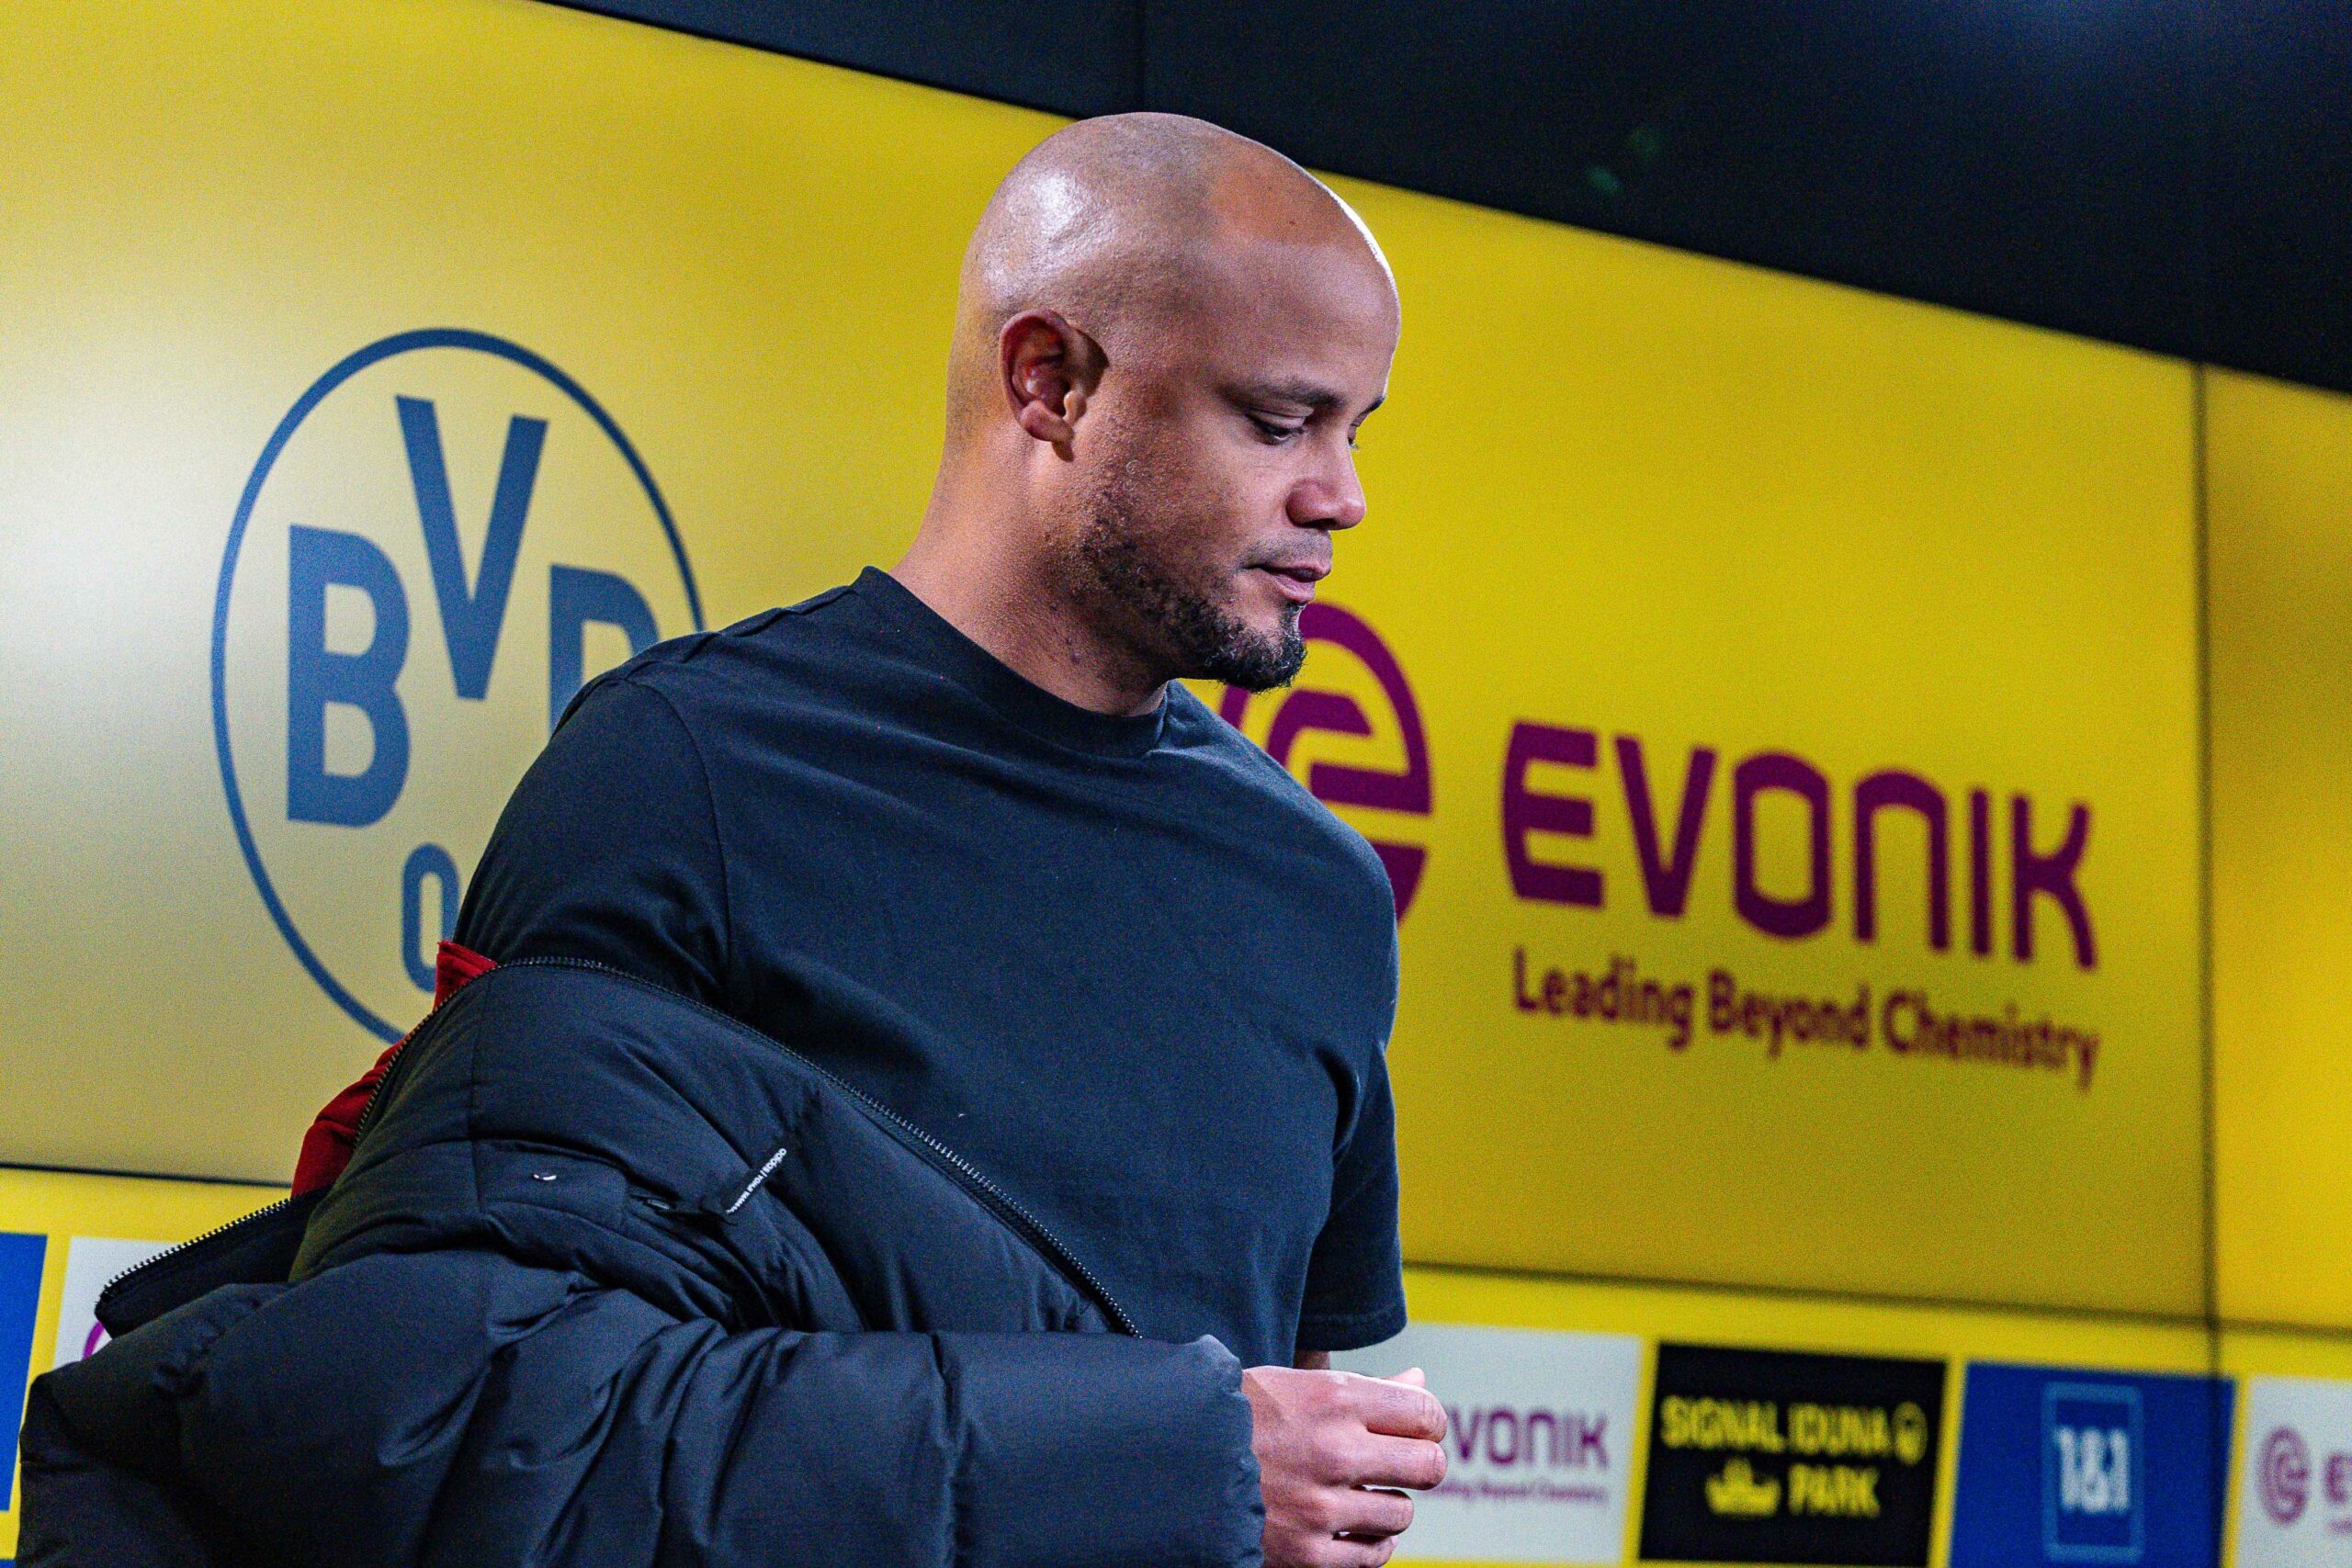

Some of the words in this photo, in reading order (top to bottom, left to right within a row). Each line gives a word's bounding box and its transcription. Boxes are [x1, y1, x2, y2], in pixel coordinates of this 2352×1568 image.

[1501, 718, 2098, 972] EVONIK
[1514, 946, 1695, 1051] Leading
[1708, 968, 1871, 1059] Beyond
[1883, 989, 2098, 1093] Chemistry
[1446, 1405, 1608, 1470] VONIK
[1660, 1395, 1785, 1452] SIGNAL
[1788, 1404, 1890, 1457] IDUNA
[1788, 1462, 1880, 1517] PARK
